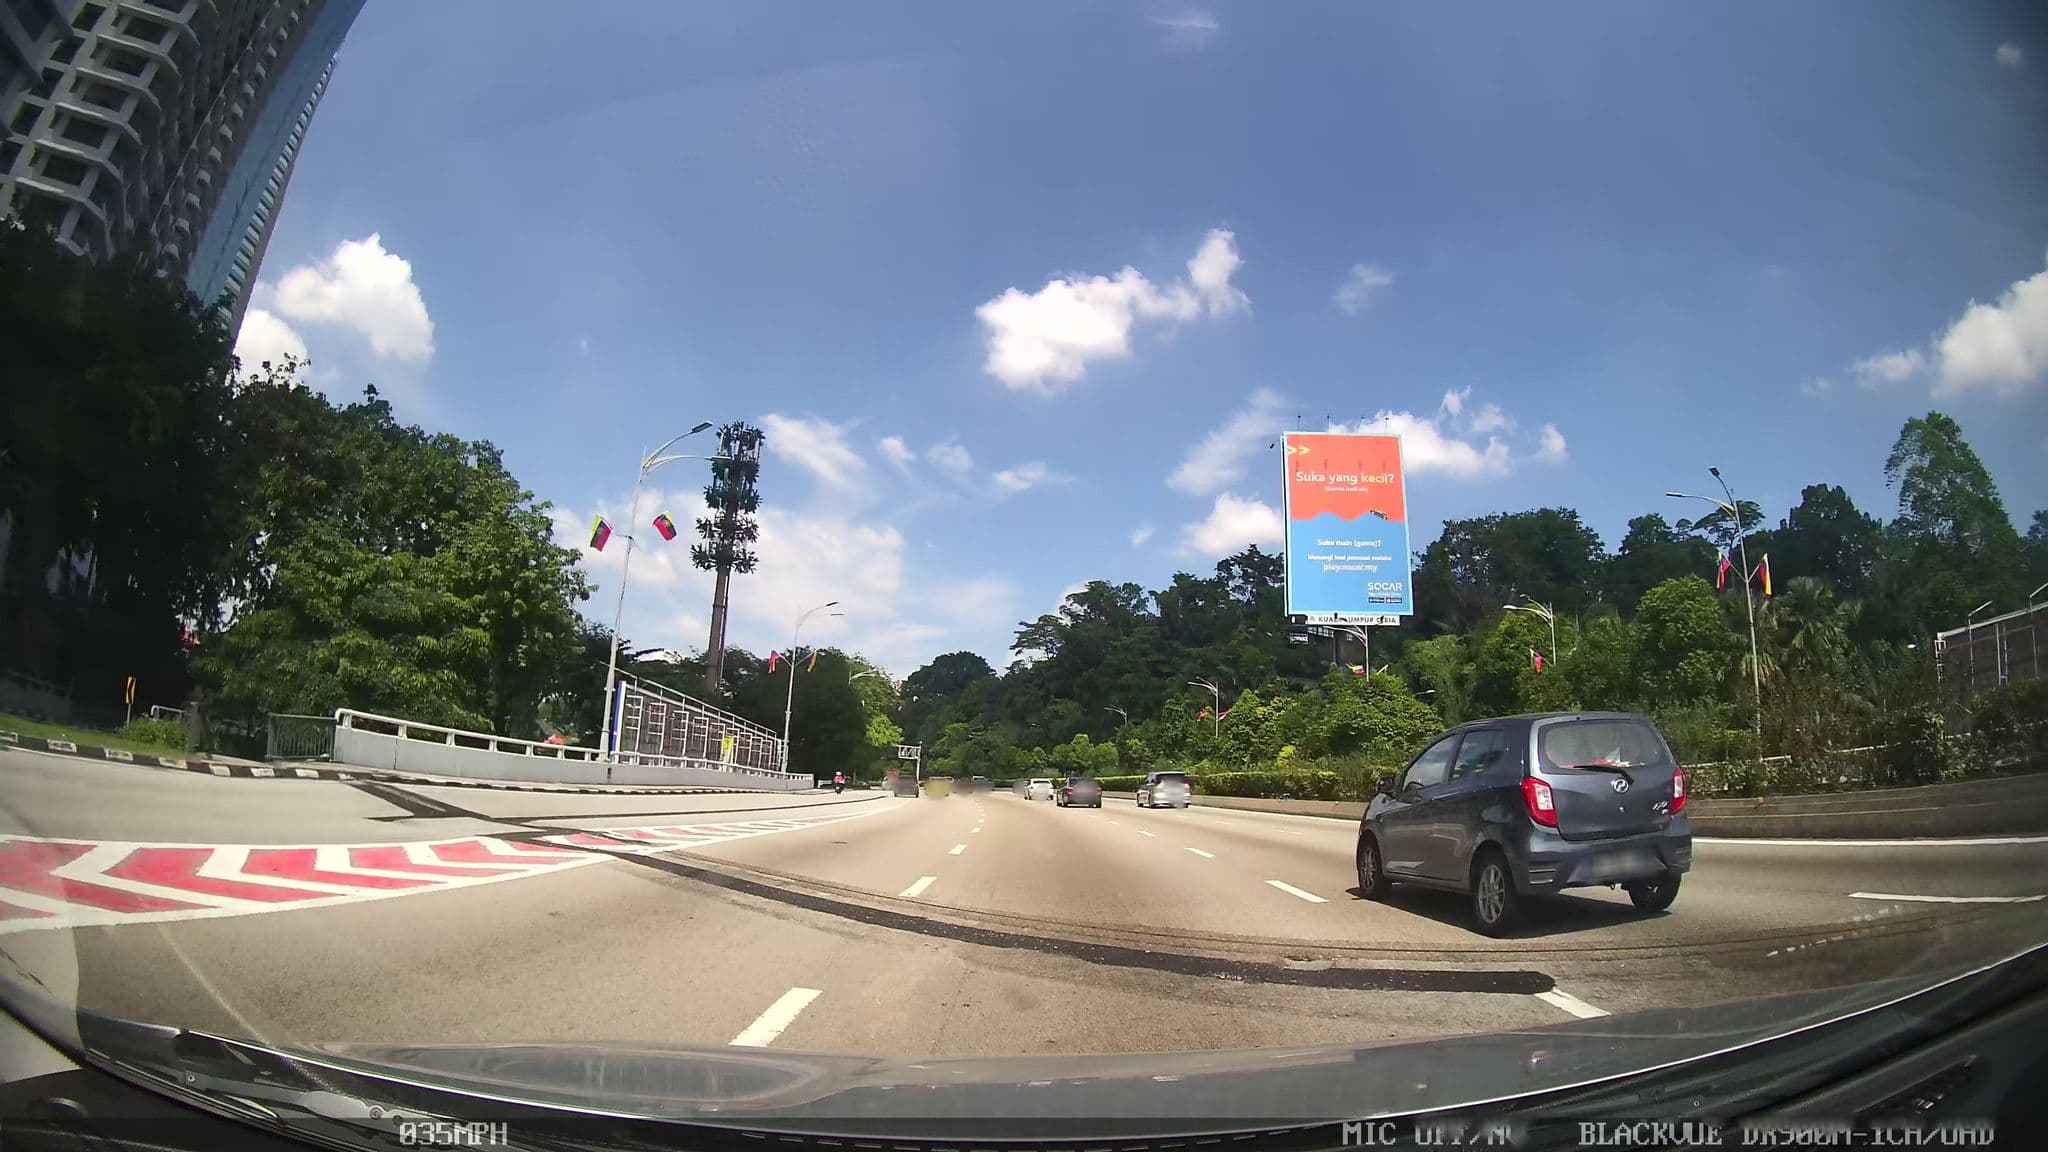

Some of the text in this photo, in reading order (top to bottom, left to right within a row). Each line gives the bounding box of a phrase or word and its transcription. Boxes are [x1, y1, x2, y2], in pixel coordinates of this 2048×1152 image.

[1296, 471, 1394, 485] Suka yang kecil?
[1368, 582, 1402, 591] SOCAR
[1377, 616, 1396, 624] CRIA
